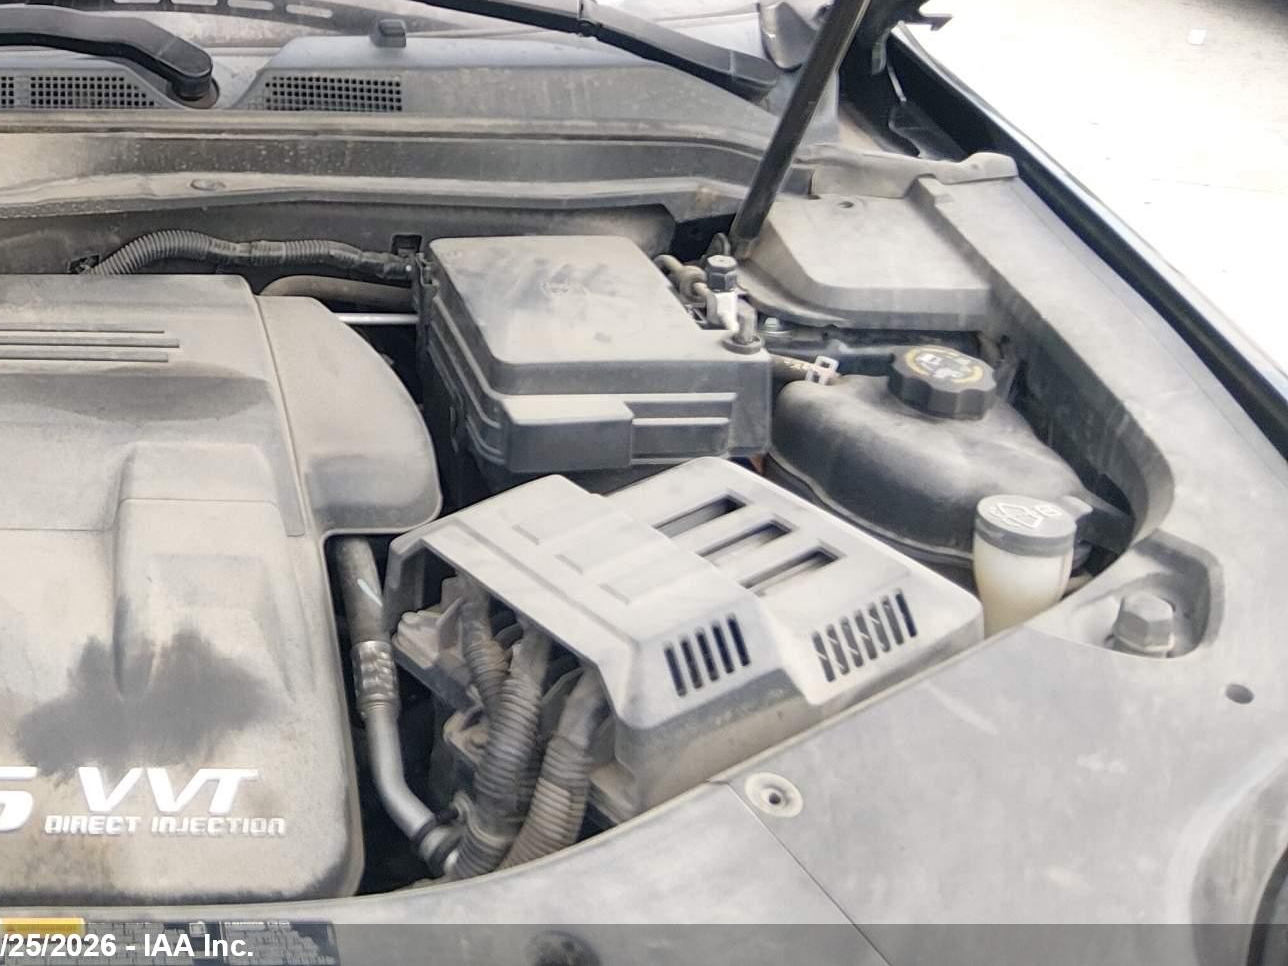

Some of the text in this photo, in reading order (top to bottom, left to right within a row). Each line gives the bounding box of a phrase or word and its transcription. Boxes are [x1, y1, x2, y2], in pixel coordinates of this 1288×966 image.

[77, 766, 260, 814] VVT
[44, 815, 287, 836] DIRECT INJECTION
